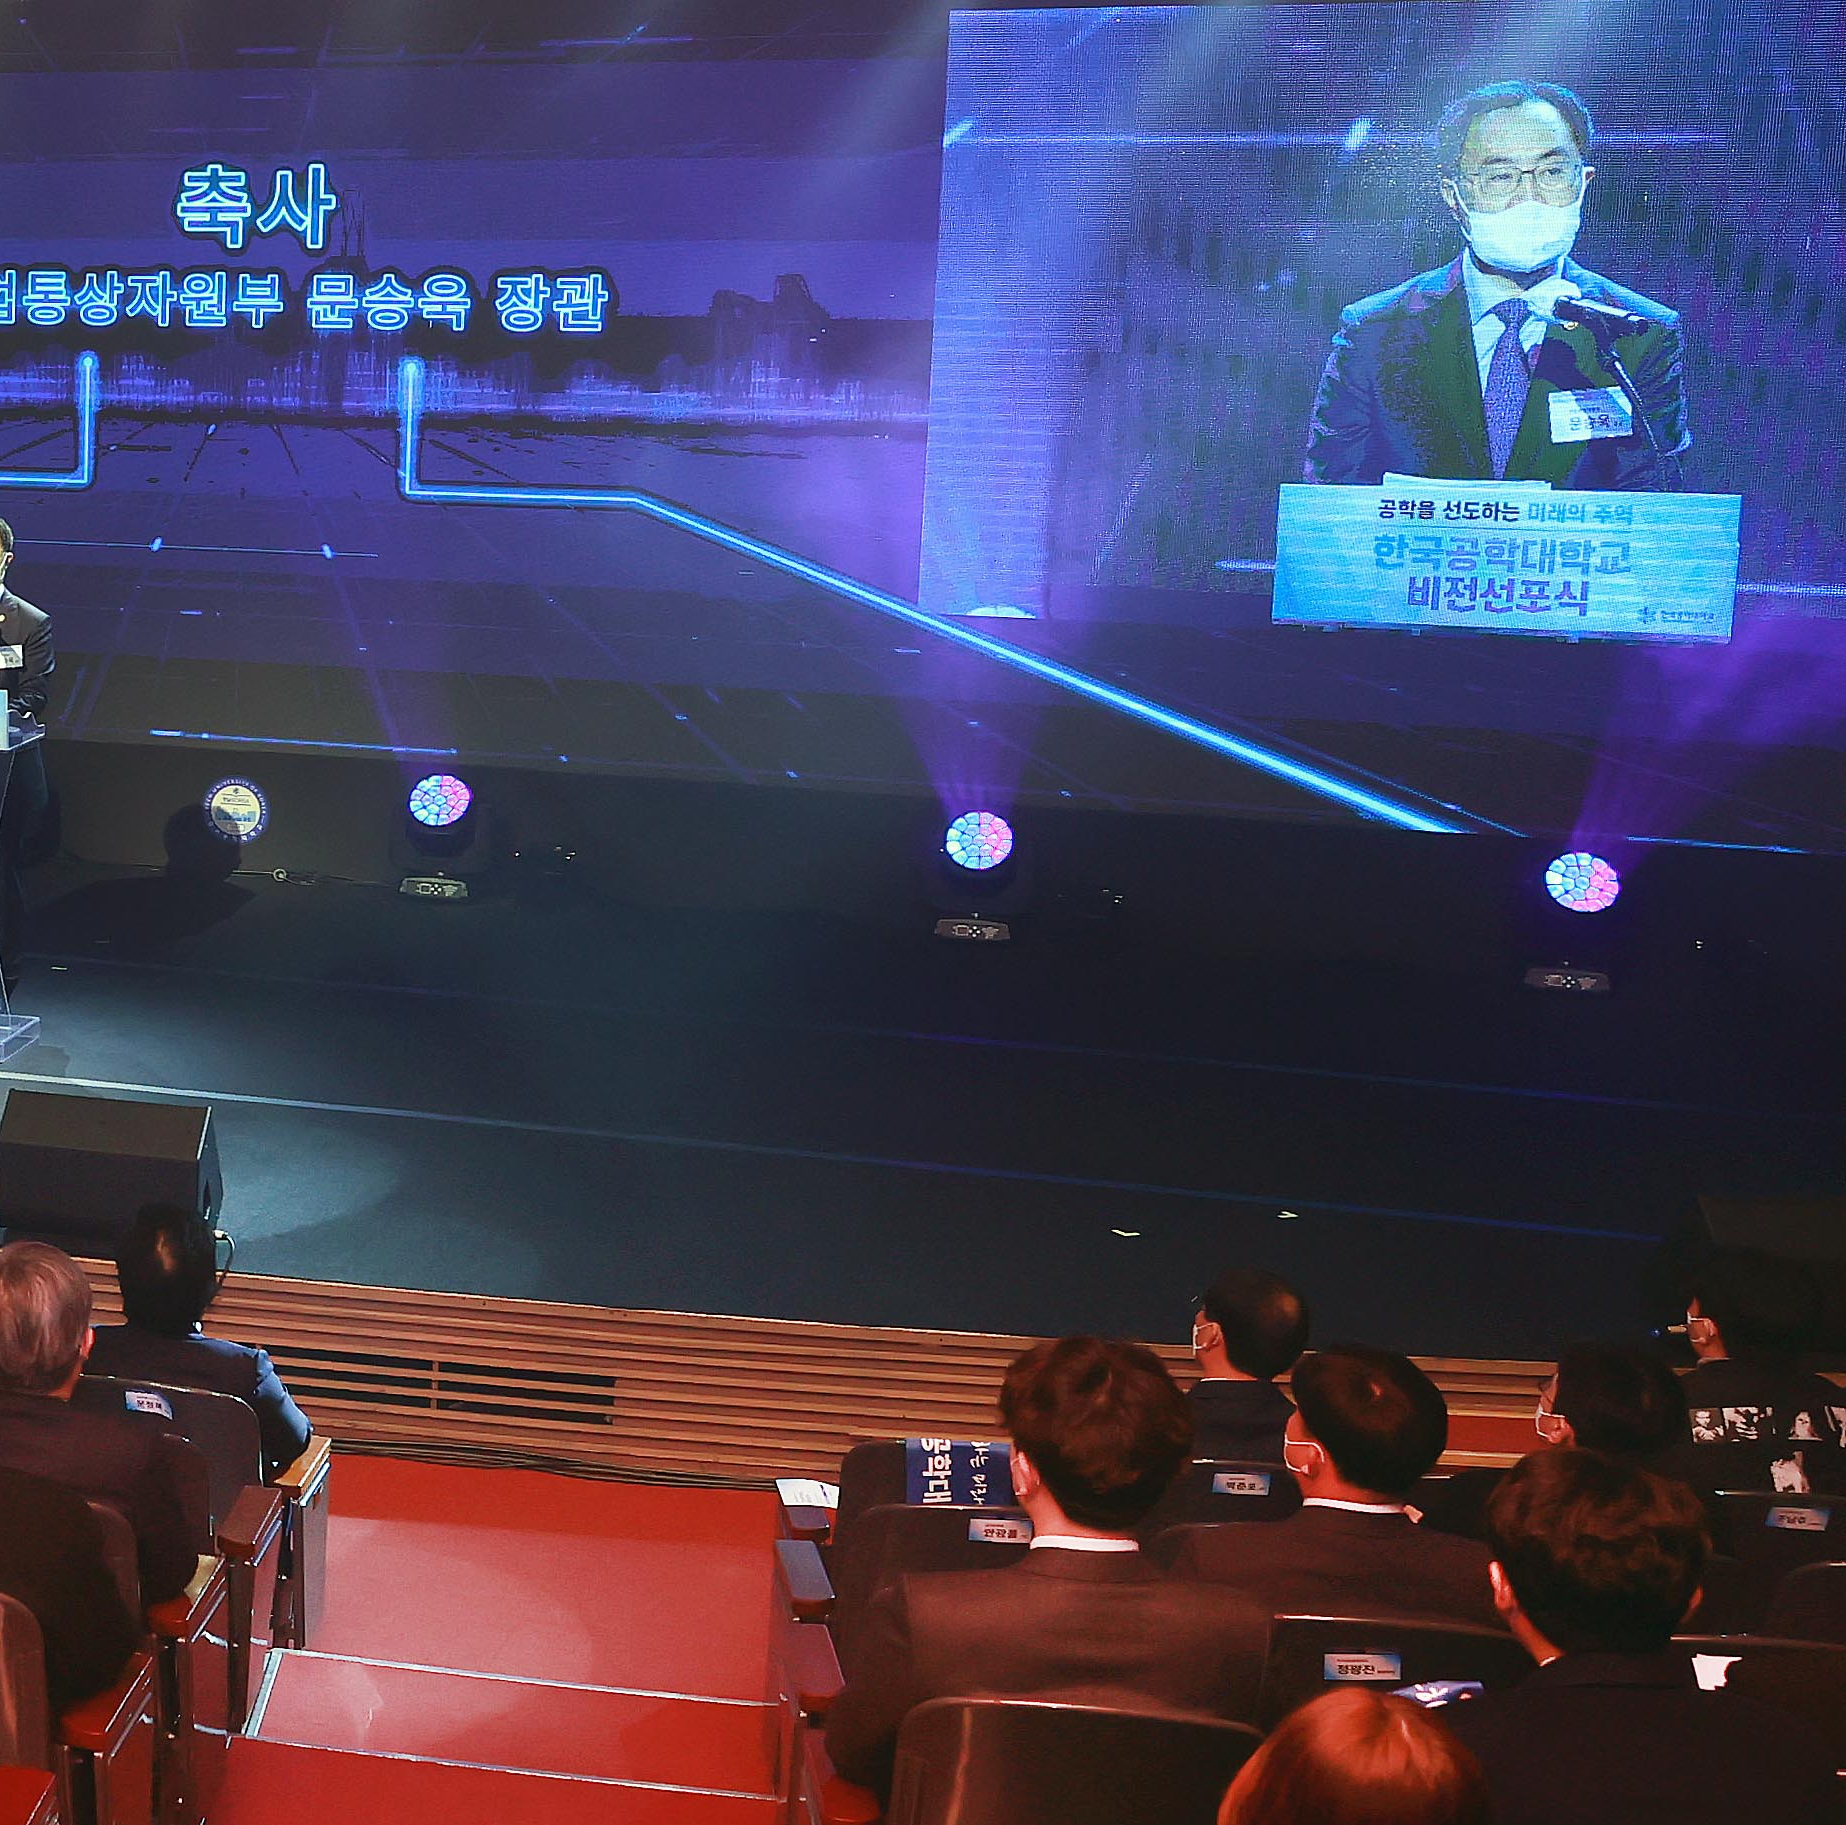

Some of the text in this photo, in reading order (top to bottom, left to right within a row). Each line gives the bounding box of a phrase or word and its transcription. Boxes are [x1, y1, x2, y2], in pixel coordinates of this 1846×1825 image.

[176, 162, 338, 250] 축사
[305, 272, 472, 332] 문승욱
[494, 272, 611, 333] 장관
[1377, 499, 1634, 526] 공학을 선도하는 미래의 주역
[1374, 533, 1632, 576] 한국공학대학교
[1406, 575, 1591, 617] 비전선포식
